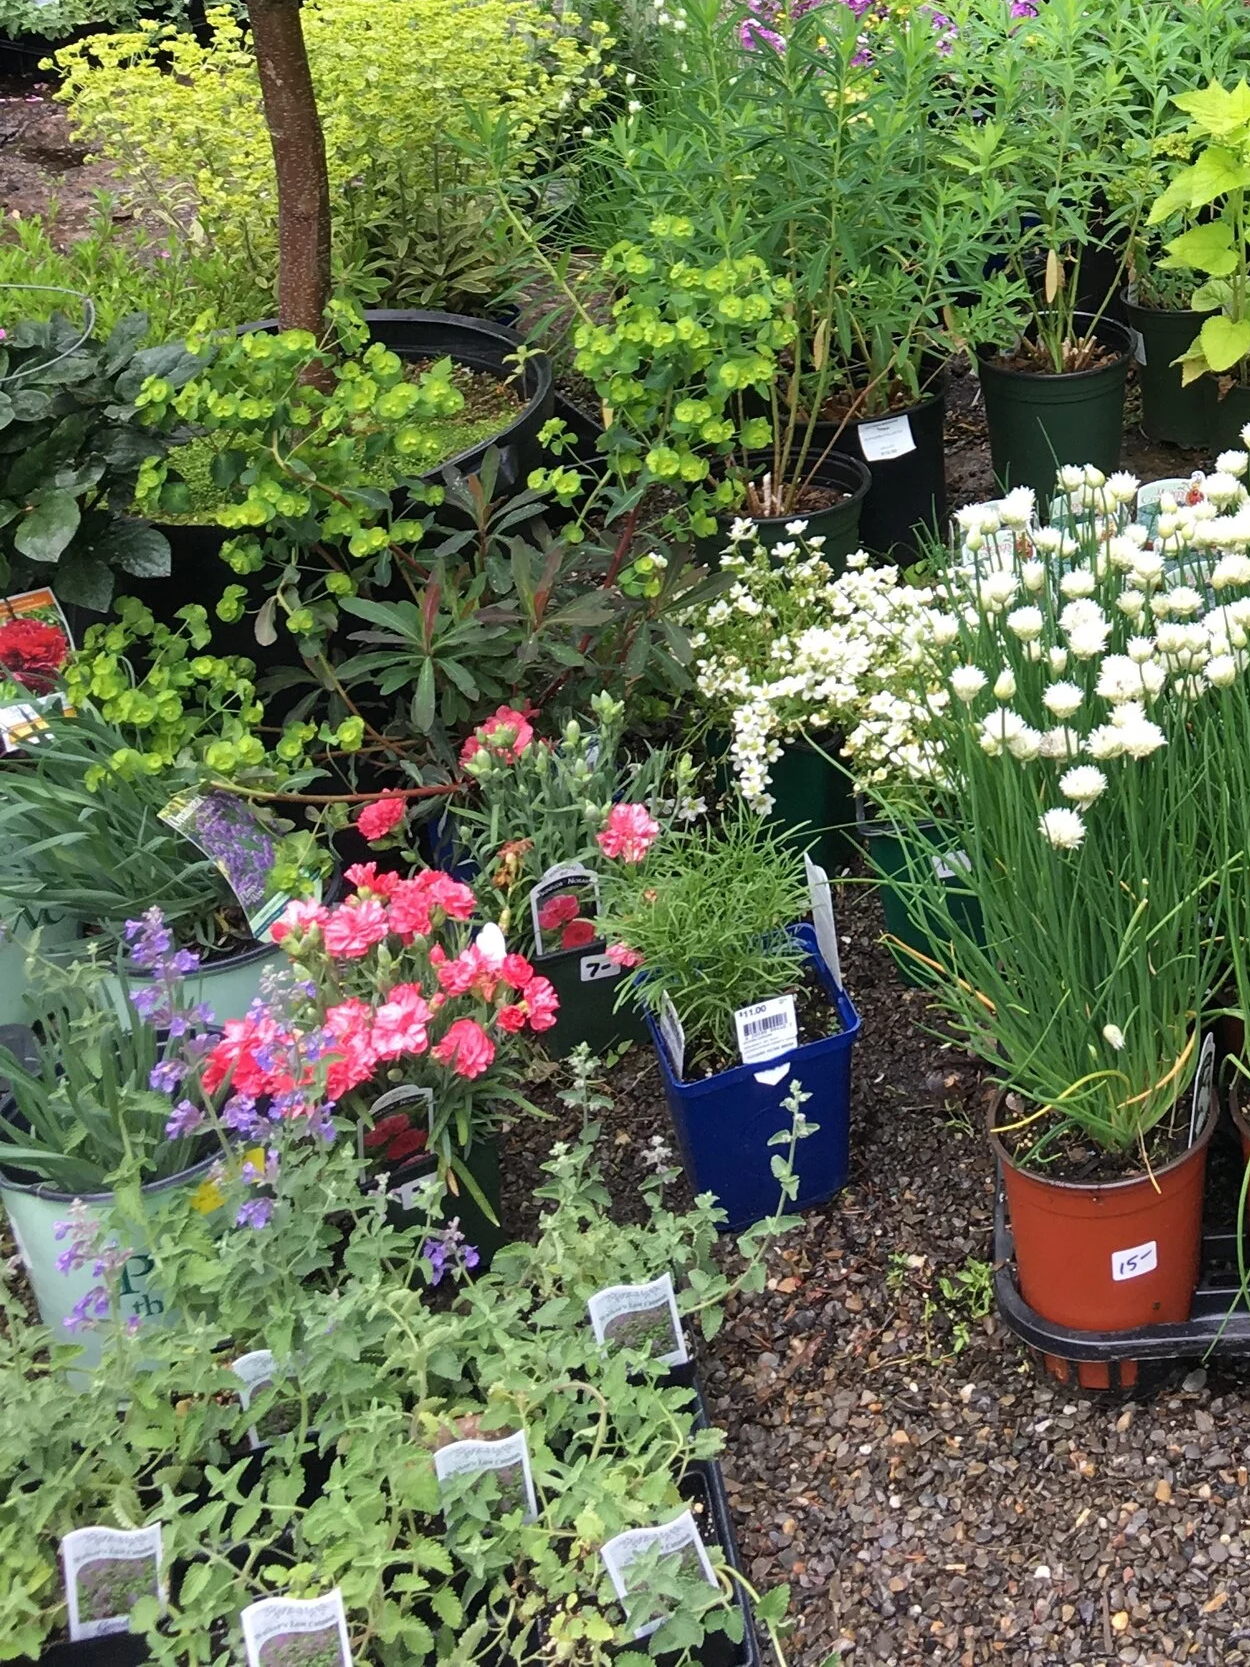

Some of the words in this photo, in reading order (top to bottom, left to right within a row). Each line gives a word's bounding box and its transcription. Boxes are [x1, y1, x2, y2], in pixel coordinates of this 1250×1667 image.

[586, 962, 612, 978] 7-
[739, 1004, 767, 1018] $11.00
[1119, 1250, 1153, 1275] 15-
